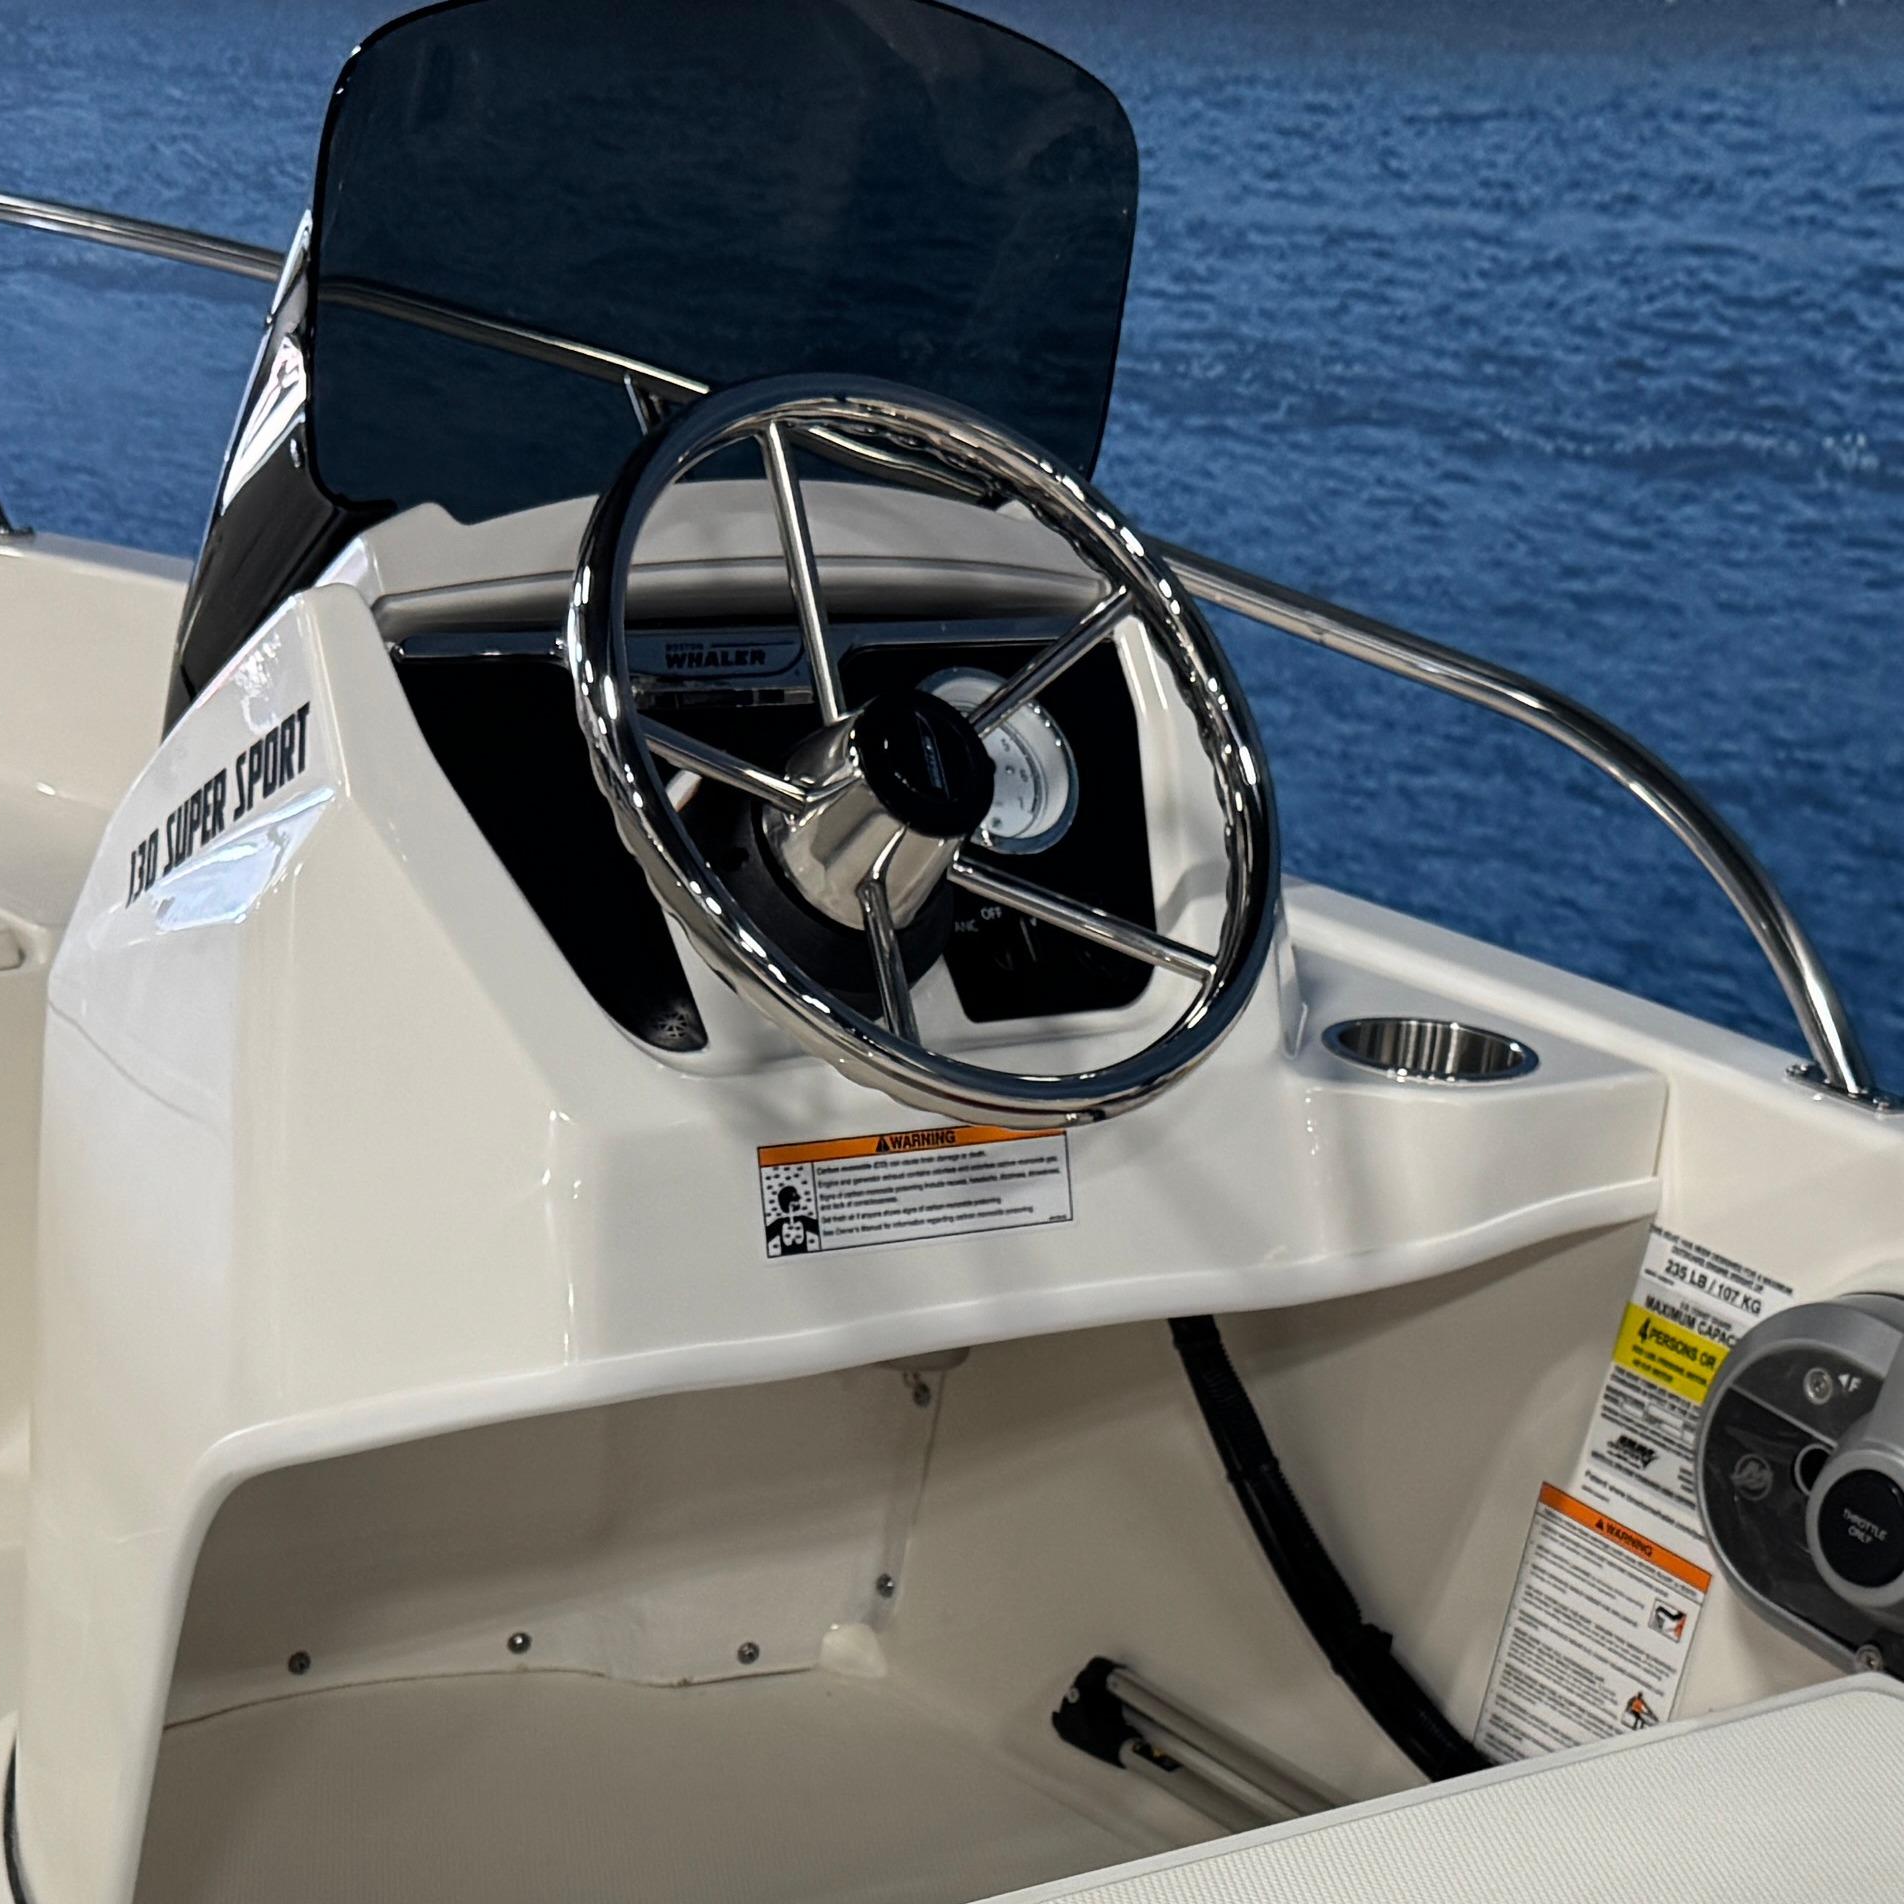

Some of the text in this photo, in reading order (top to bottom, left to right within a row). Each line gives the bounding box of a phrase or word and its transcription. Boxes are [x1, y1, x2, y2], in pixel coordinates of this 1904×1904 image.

[665, 649, 767, 669] WHALER
[126, 701, 311, 909] 130 SUPER SPORT
[979, 905, 1004, 921] OFF
[891, 1129, 957, 1151] WARNING
[1665, 1258, 1687, 1280] 235
[1689, 1269, 1708, 1289] LB
[1718, 1283, 1740, 1303] 107
[1741, 1294, 1763, 1316] KG
[1645, 1294, 1697, 1330] MAXIMUM
[1649, 1326, 1699, 1362] PERSONS
[1699, 1352, 1718, 1370] OR
[1848, 1376, 1862, 1393] F
[1606, 1522, 1653, 1559] WARNING
[1843, 1507, 1889, 1542] THROTTLE
[1848, 1525, 1873, 1544] ONLY
